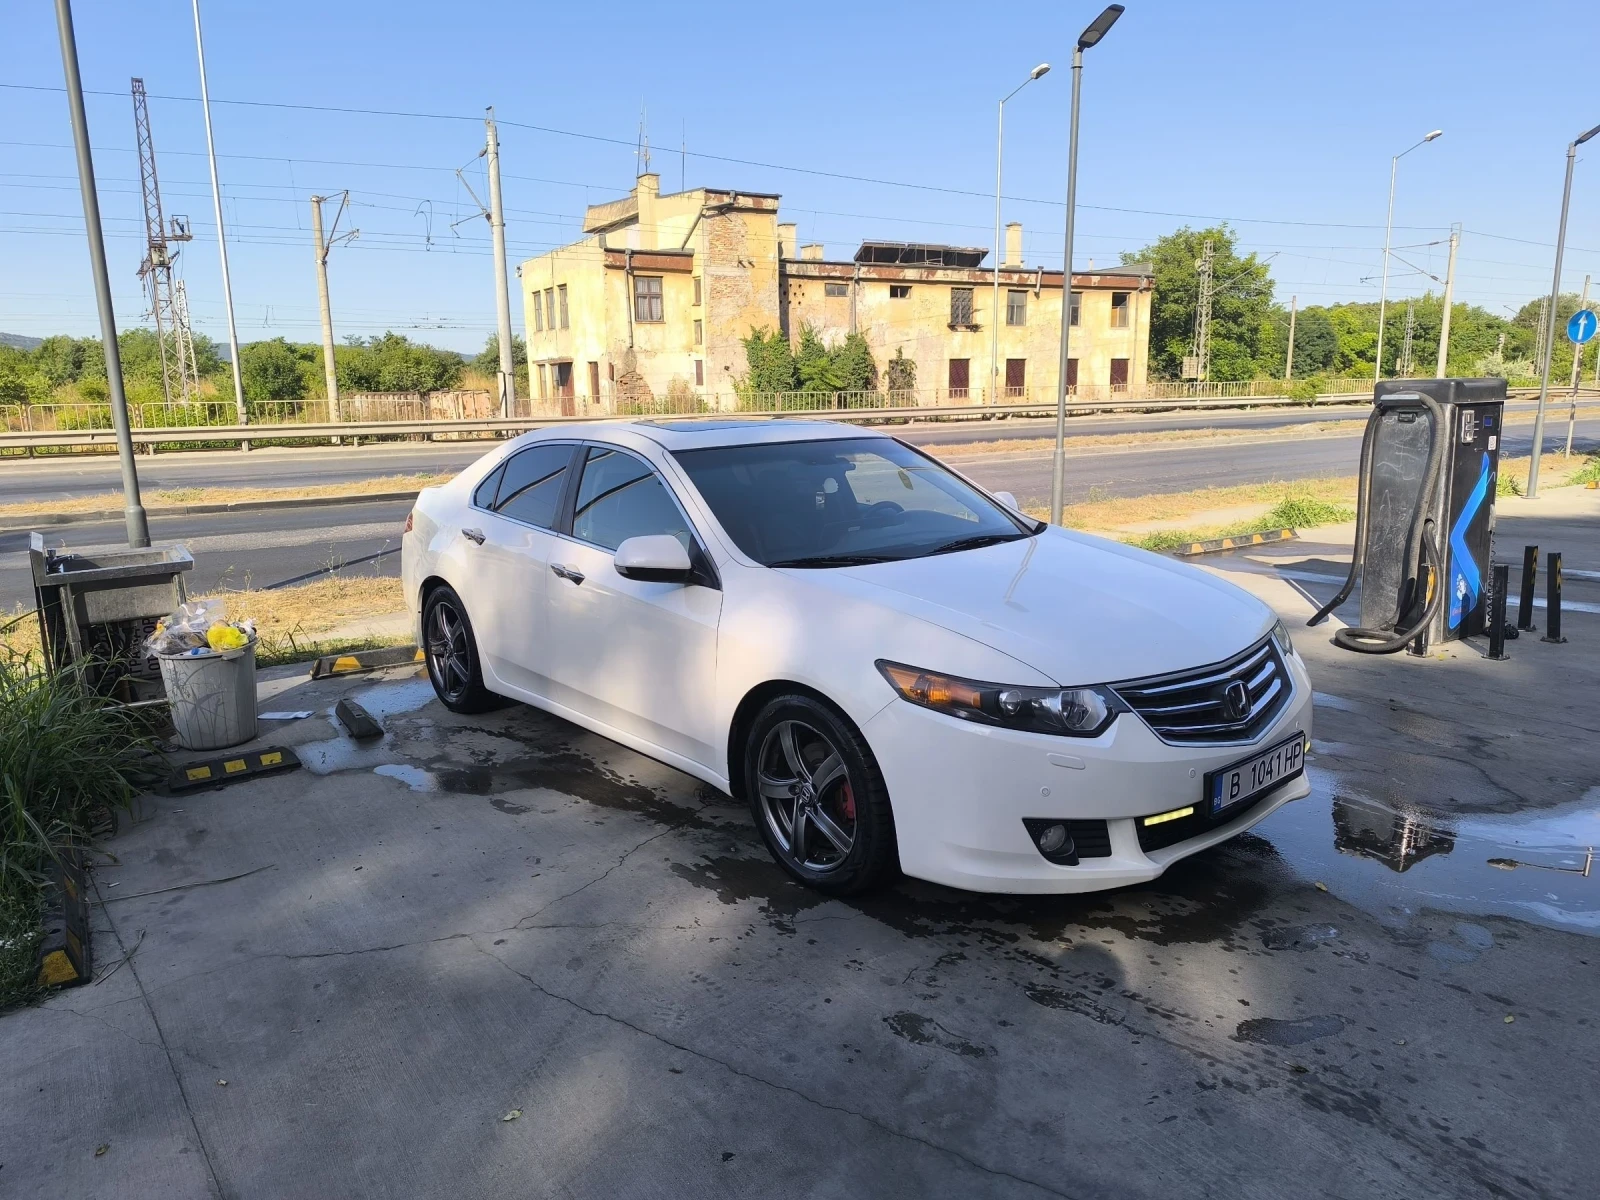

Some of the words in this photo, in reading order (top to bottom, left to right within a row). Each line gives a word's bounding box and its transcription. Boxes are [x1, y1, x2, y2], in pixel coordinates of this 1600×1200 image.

[1230, 772, 1240, 800] B
[1251, 752, 1281, 790] 1041
[1213, 796, 1221, 806] BG
